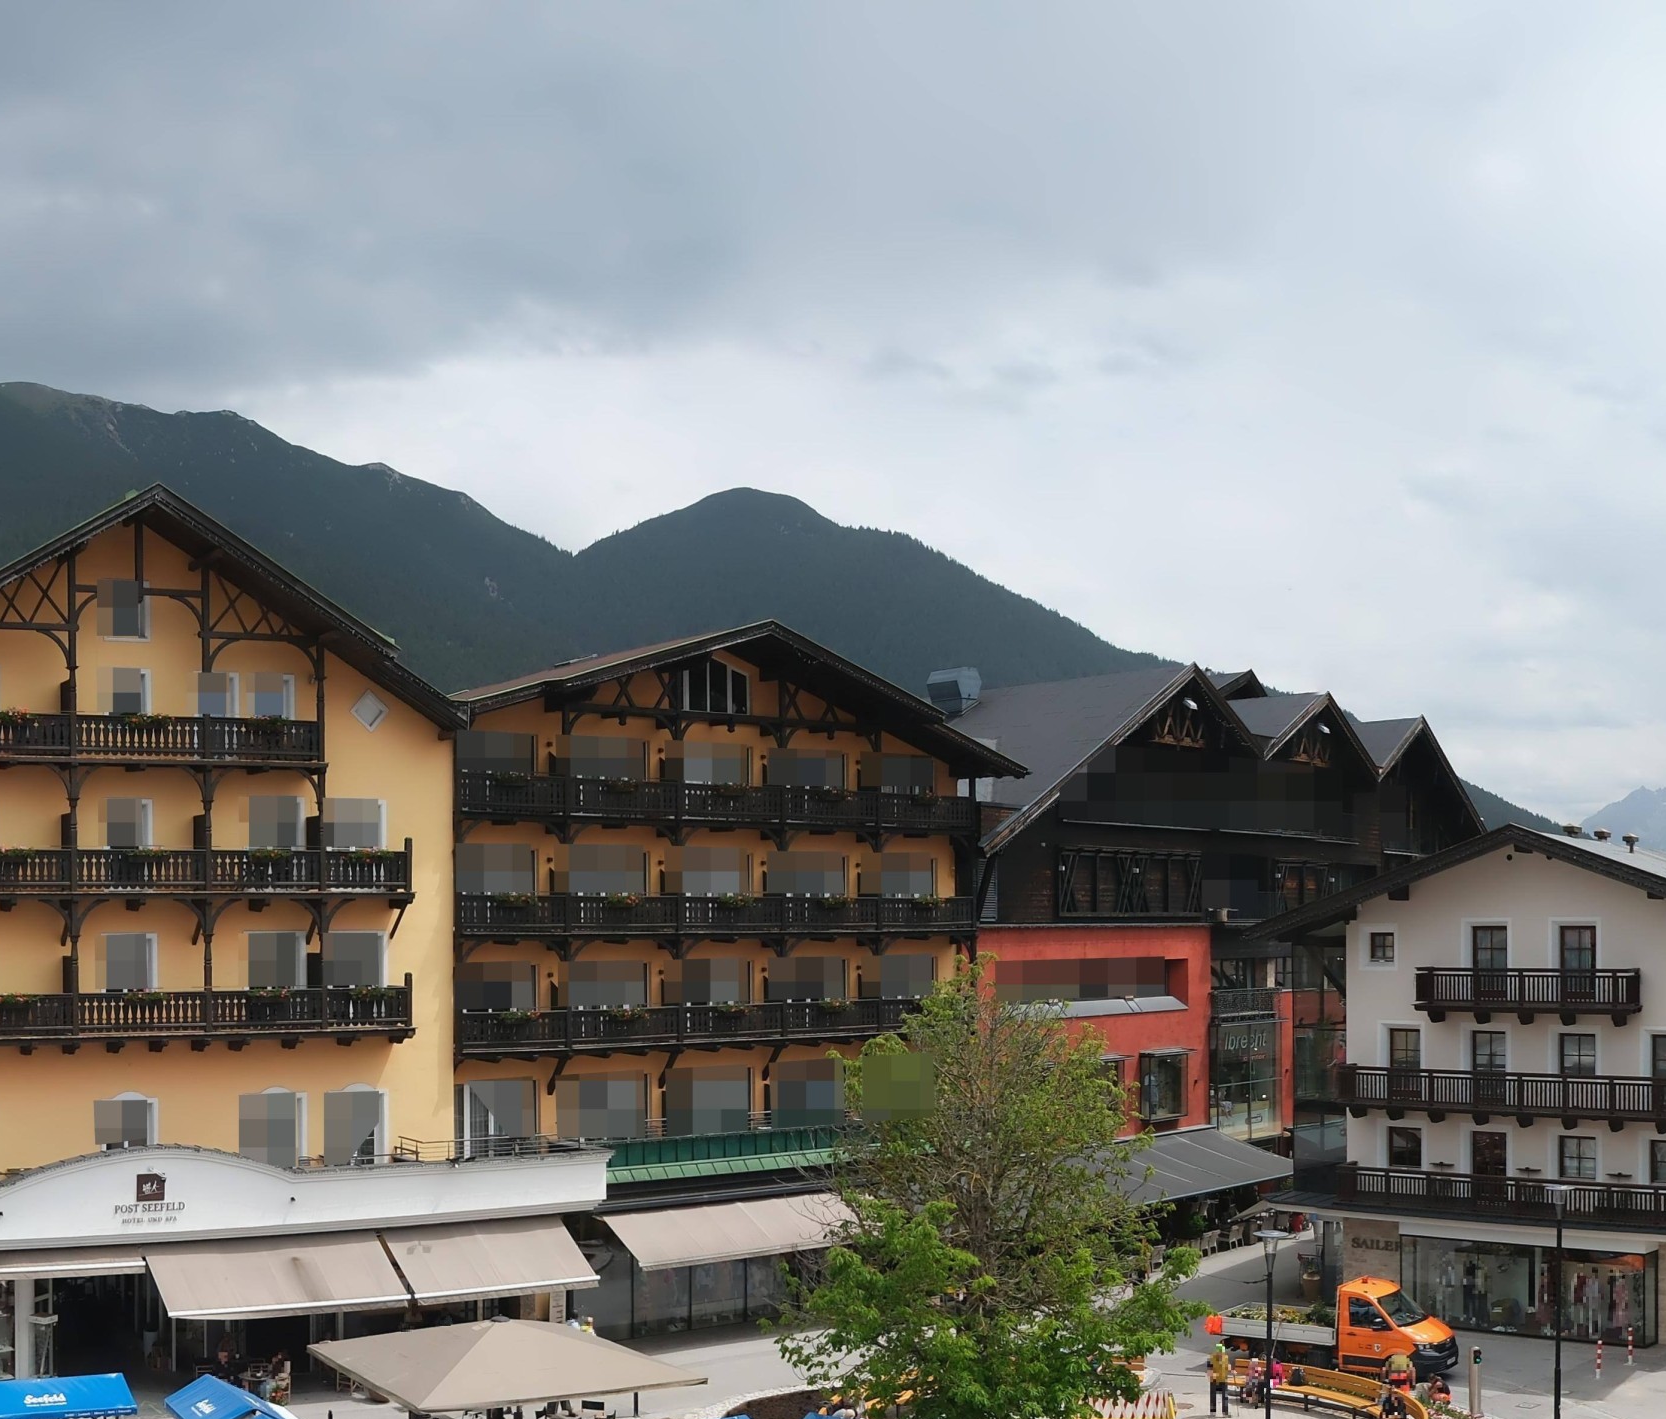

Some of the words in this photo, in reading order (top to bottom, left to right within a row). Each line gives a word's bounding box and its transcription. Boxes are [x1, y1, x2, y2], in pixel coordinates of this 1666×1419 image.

[114, 1203, 140, 1214] POST
[142, 1201, 186, 1213] SEEFELD
[23, 1392, 68, 1405] Seefeld
